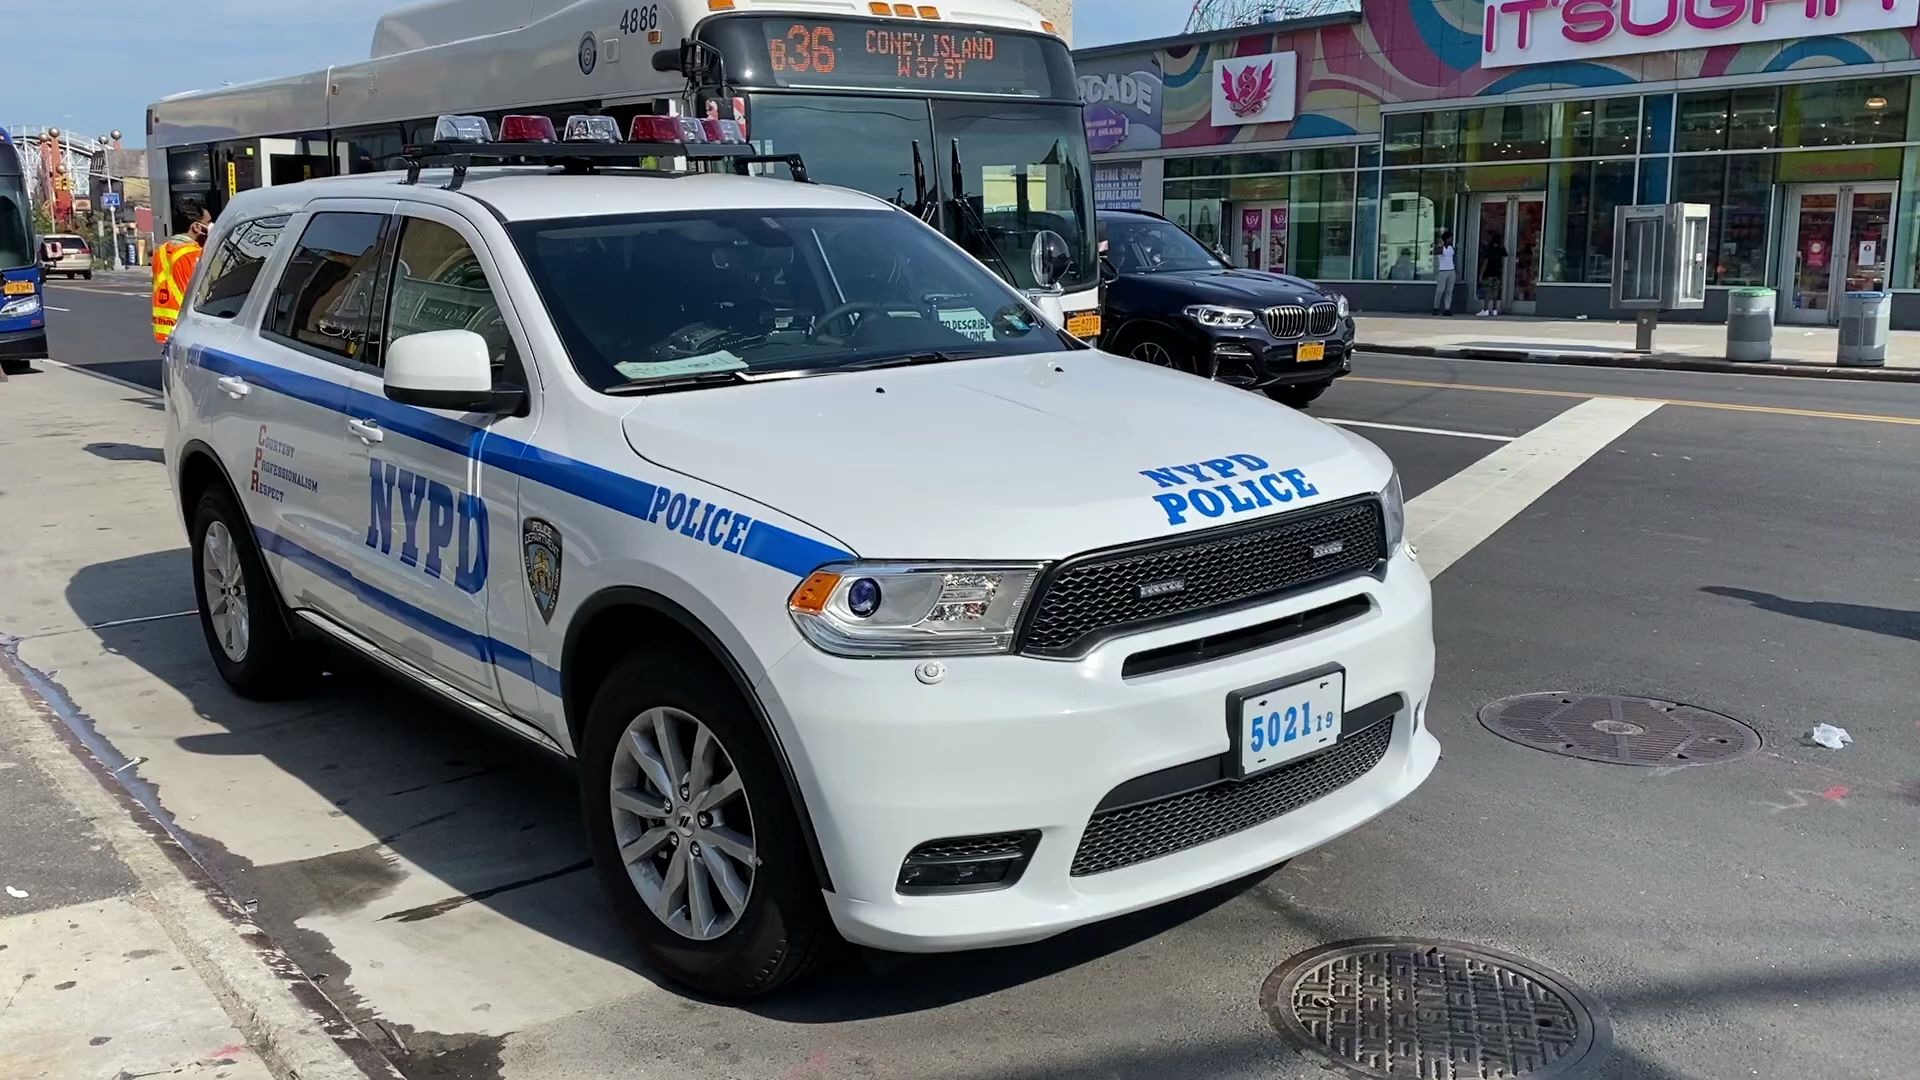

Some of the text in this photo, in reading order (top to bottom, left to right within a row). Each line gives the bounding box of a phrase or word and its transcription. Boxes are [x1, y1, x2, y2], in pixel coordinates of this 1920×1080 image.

[620, 4, 658, 35] 4886
[865, 30, 994, 60] CONEY ISLAND
[898, 56, 964, 80] W 37 ST
[952, 319, 990, 330] DESCRIBE
[251, 470, 285, 503] RESPECT
[1138, 453, 1269, 488] NYPD
[1152, 468, 1320, 526] POLICE
[365, 457, 489, 595] NYPD
[648, 486, 752, 554] POLICE
[1250, 701, 1334, 753] 5021 19
